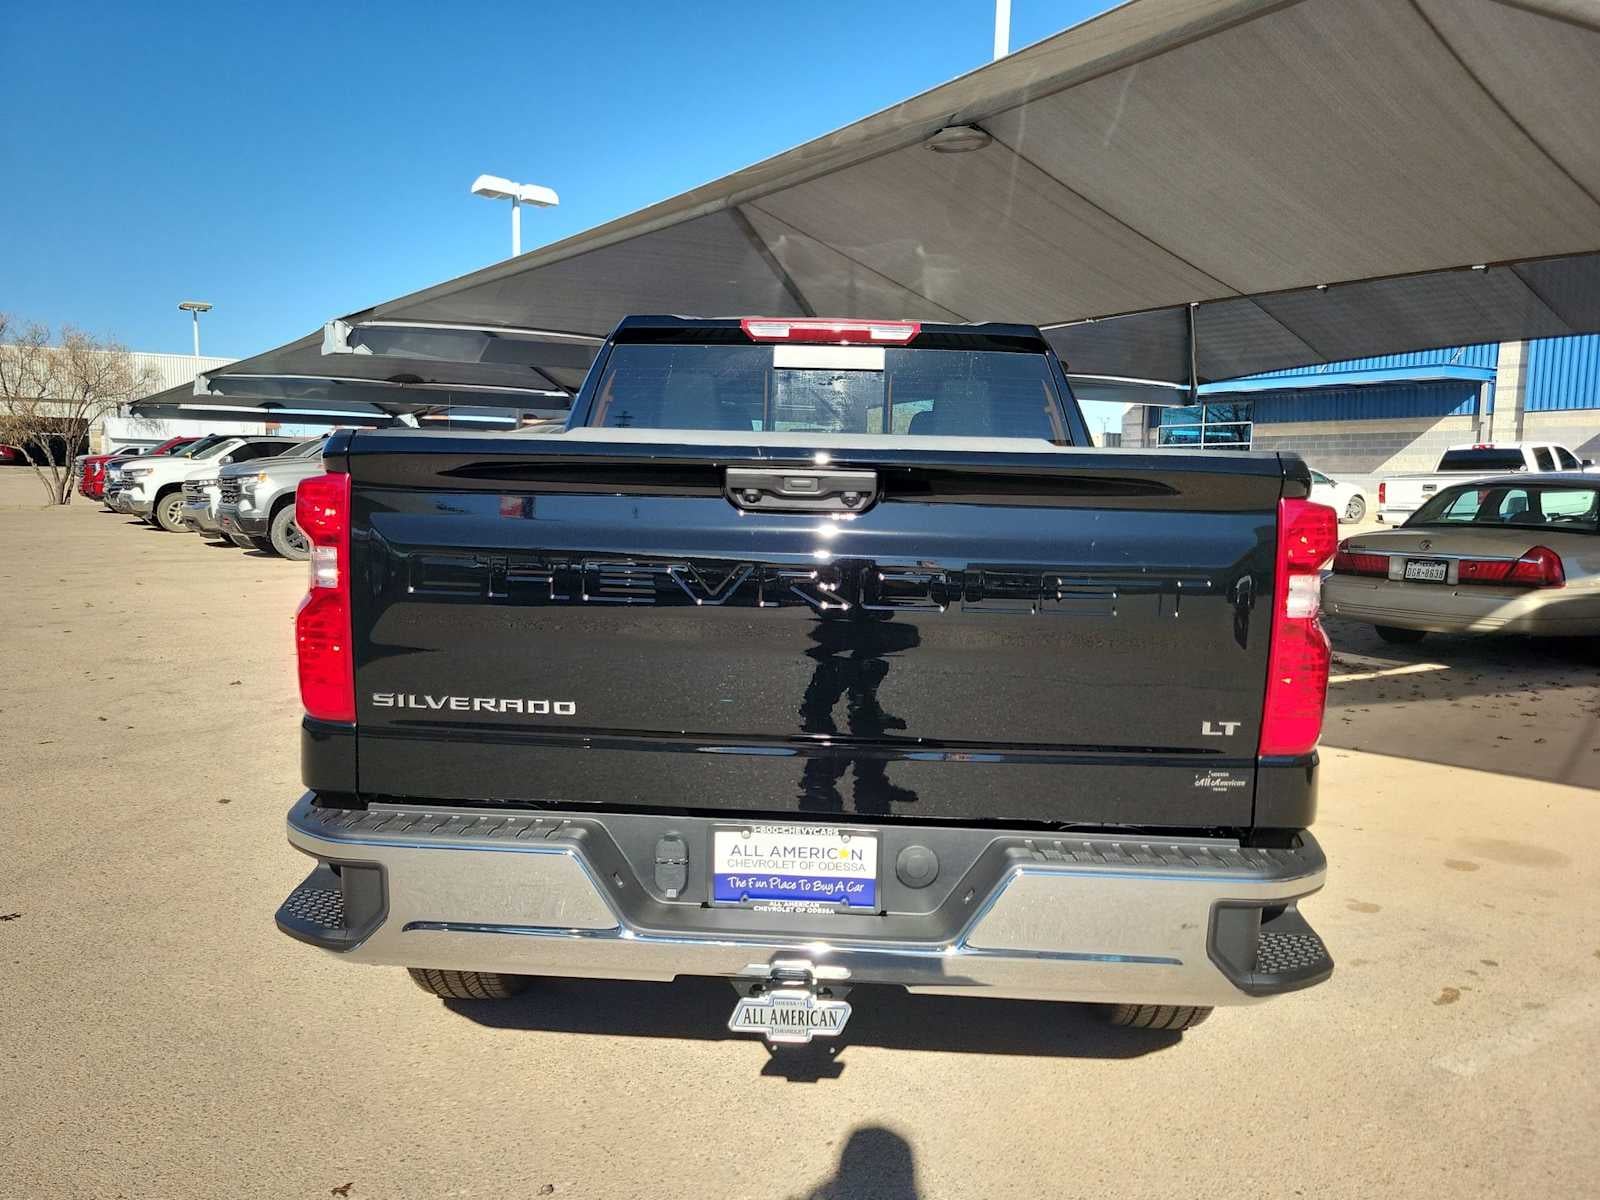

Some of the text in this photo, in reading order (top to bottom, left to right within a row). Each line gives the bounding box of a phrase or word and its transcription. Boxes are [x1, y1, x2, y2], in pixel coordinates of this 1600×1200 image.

[372, 692, 576, 716] SILVERADO
[1201, 720, 1241, 736] LT
[730, 844, 764, 858] ALL
[727, 859, 866, 872] CHEVROLET OF ODESSA
[727, 876, 864, 895] The Fun Place To Buy A Car
[753, 905, 794, 913] CHEVROLET
[743, 1007, 838, 1027] ALL AMERICAN
